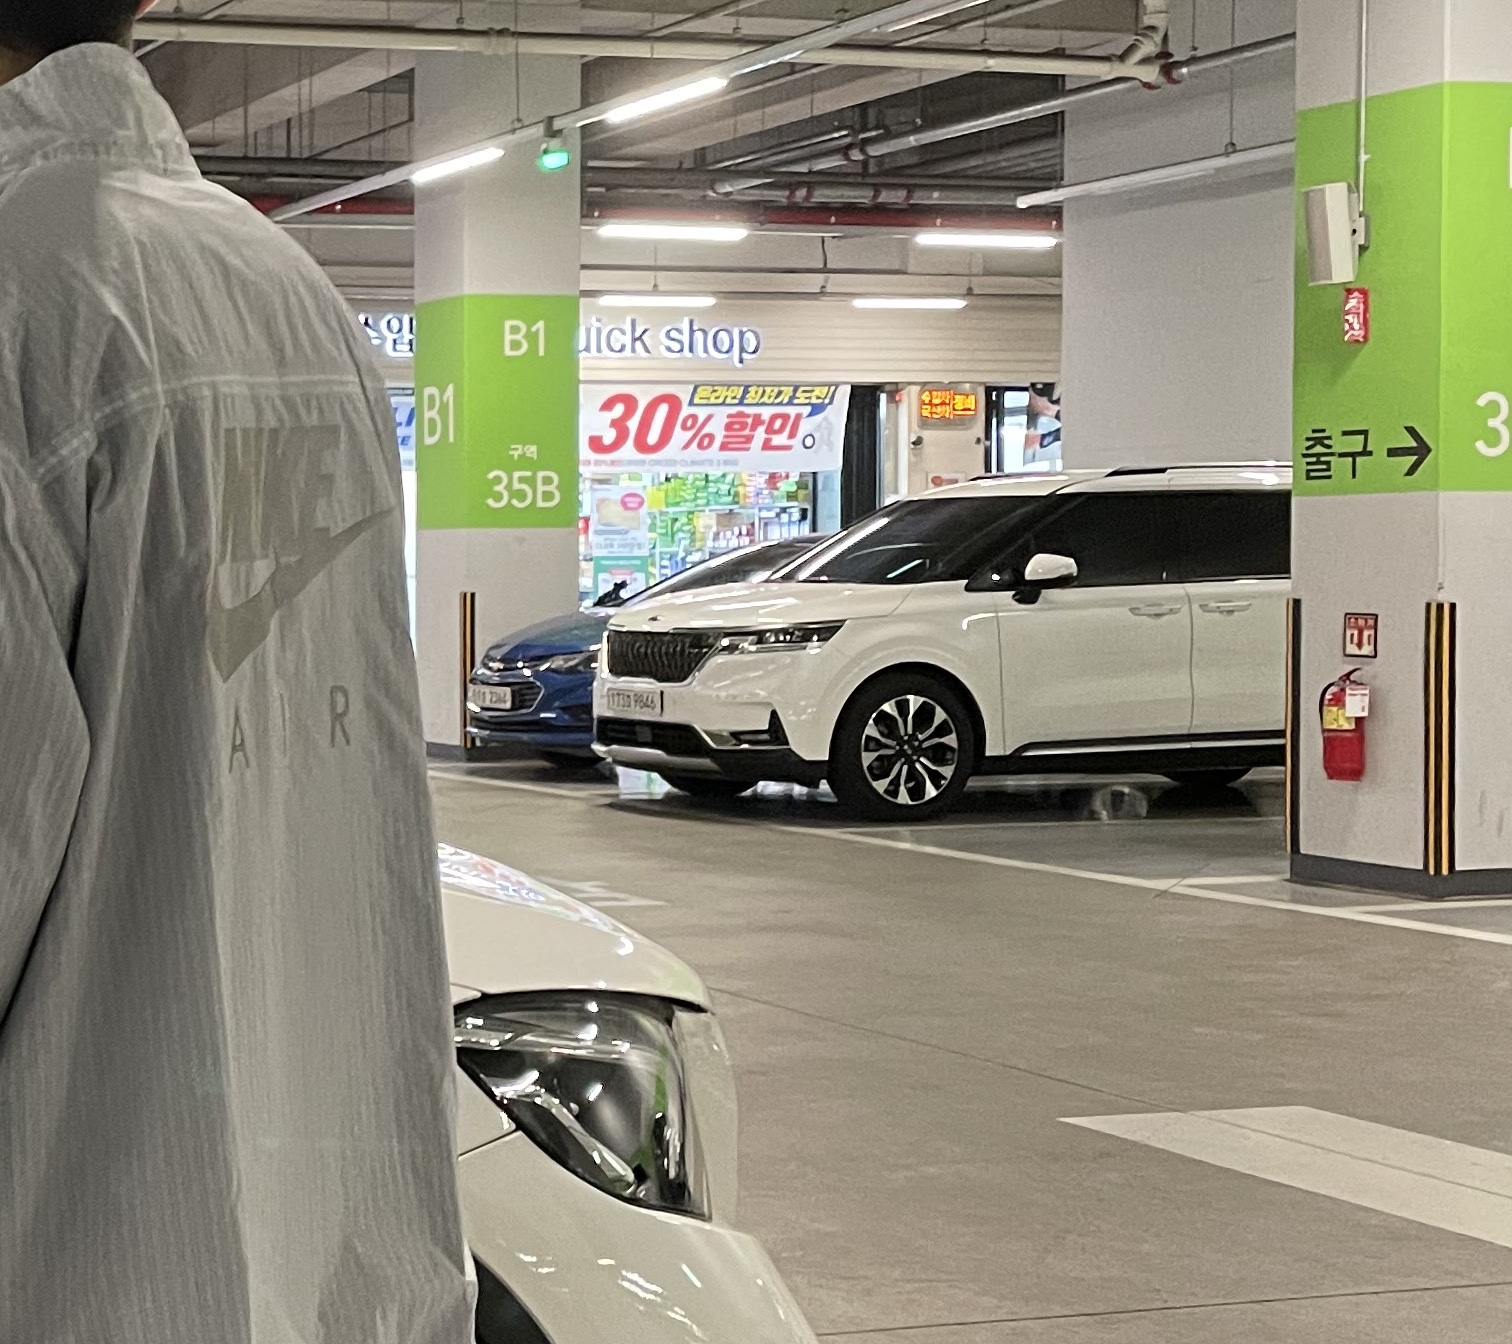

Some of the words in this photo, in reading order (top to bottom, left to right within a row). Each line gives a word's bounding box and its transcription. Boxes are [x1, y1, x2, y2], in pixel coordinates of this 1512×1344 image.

[503, 320, 546, 357] B1
[577, 317, 651, 357] uick
[659, 317, 761, 367] shop
[423, 383, 455, 446] B1
[508, 443, 538, 461] 구역
[1300, 428, 1374, 481] 출구
[486, 470, 561, 508] 35B
